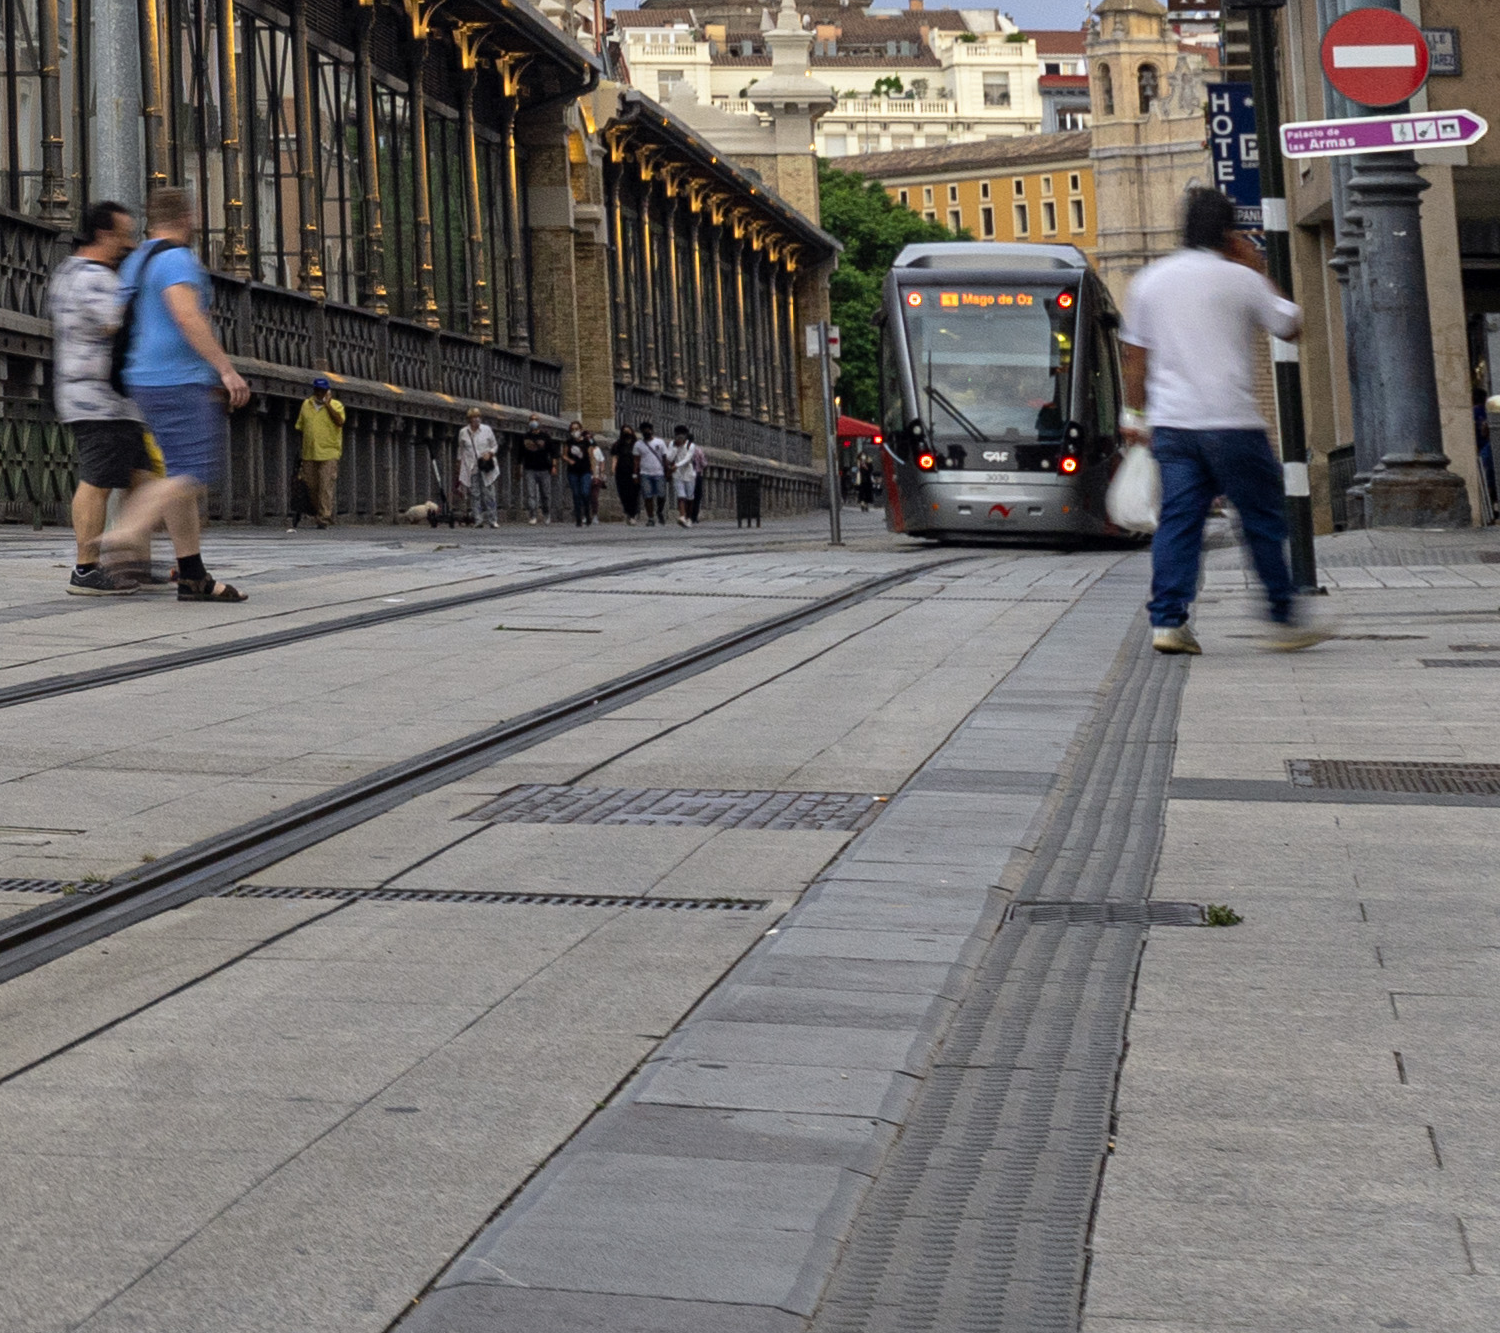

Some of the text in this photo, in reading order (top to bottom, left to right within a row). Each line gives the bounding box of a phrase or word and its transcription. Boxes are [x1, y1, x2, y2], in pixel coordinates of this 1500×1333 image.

[1286, 128, 1340, 140] Palacio de
[1288, 137, 1356, 151] las Armas
[962, 293, 995, 307] Mago
[998, 293, 1014, 306] de
[1017, 293, 1033, 306] Oz
[982, 450, 1010, 463] CAF
